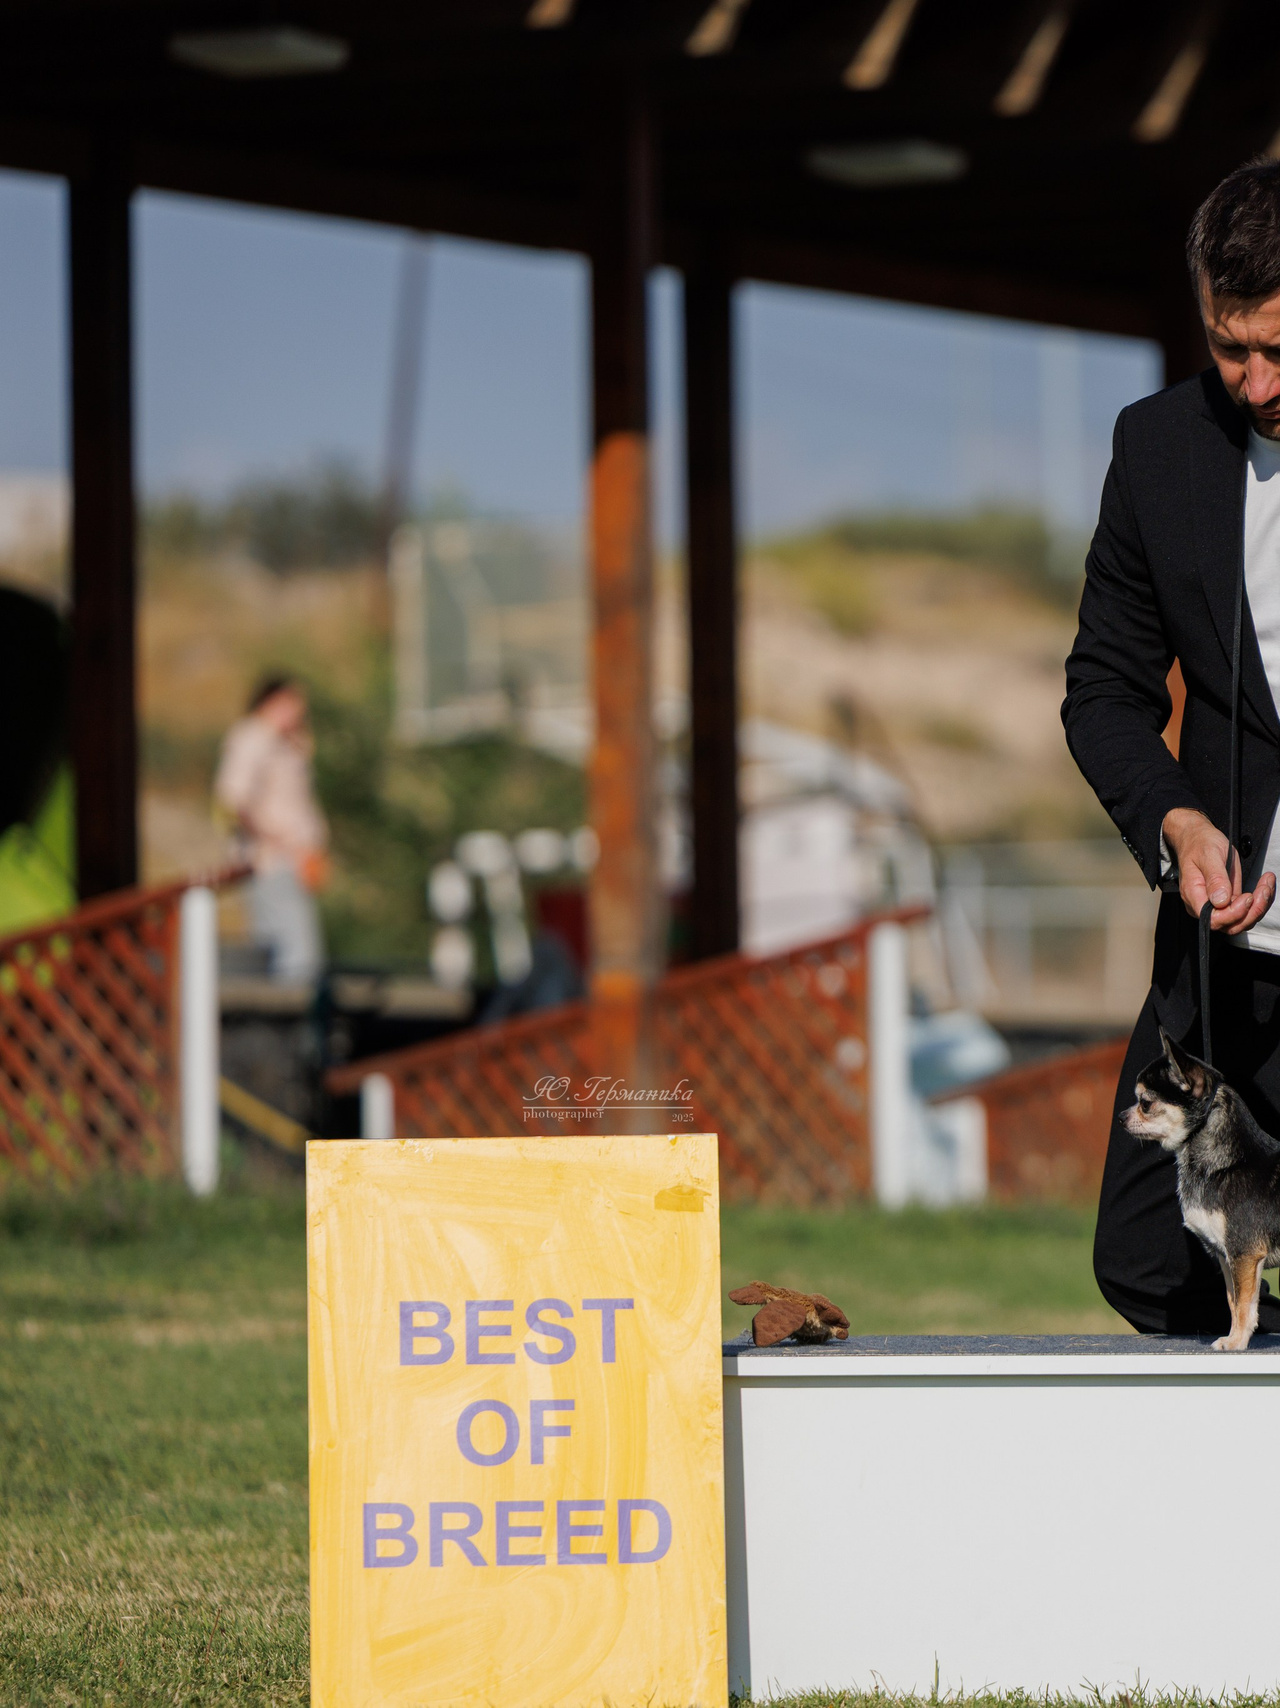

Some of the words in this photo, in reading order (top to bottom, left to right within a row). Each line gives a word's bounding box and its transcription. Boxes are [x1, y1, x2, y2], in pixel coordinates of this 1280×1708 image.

[400, 1298, 634, 1366] BEST
[456, 1399, 575, 1467] OF
[363, 1499, 672, 1568] BREED
